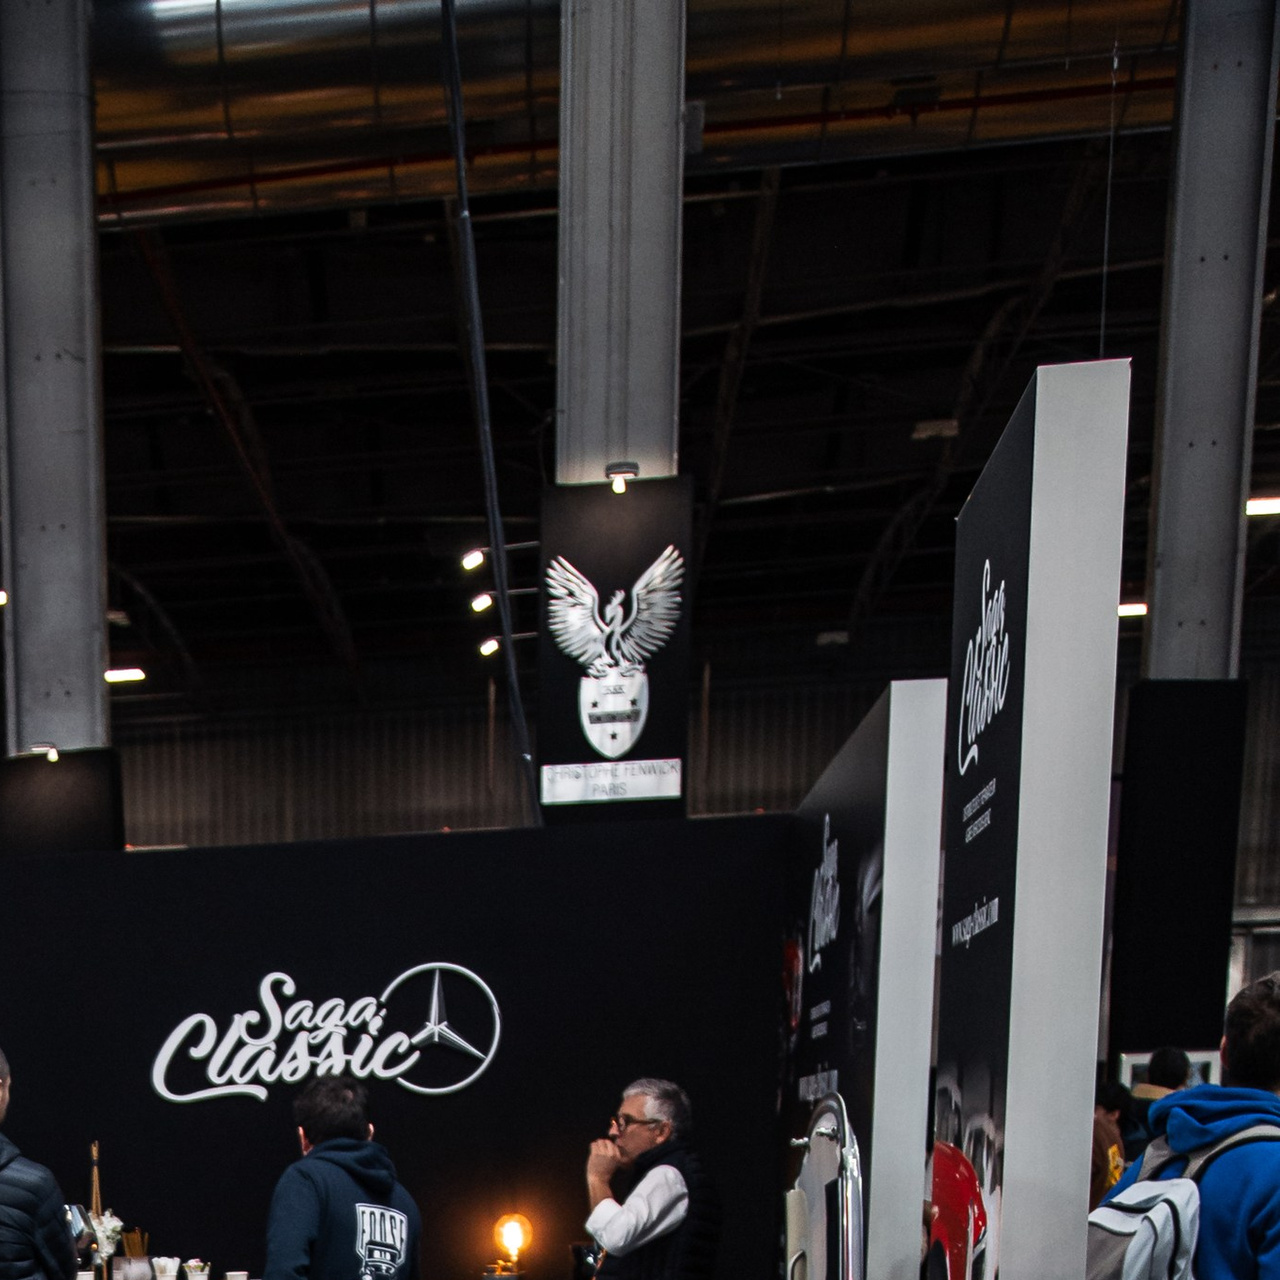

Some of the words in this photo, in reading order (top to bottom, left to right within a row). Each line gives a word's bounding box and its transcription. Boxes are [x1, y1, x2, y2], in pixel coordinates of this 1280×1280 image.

[547, 763, 619, 782] CHRISTOPHE
[625, 760, 680, 776] FENWICK
[592, 783, 628, 796] PARIS
[239, 972, 382, 1045] Saga
[152, 1009, 420, 1102] Classic
